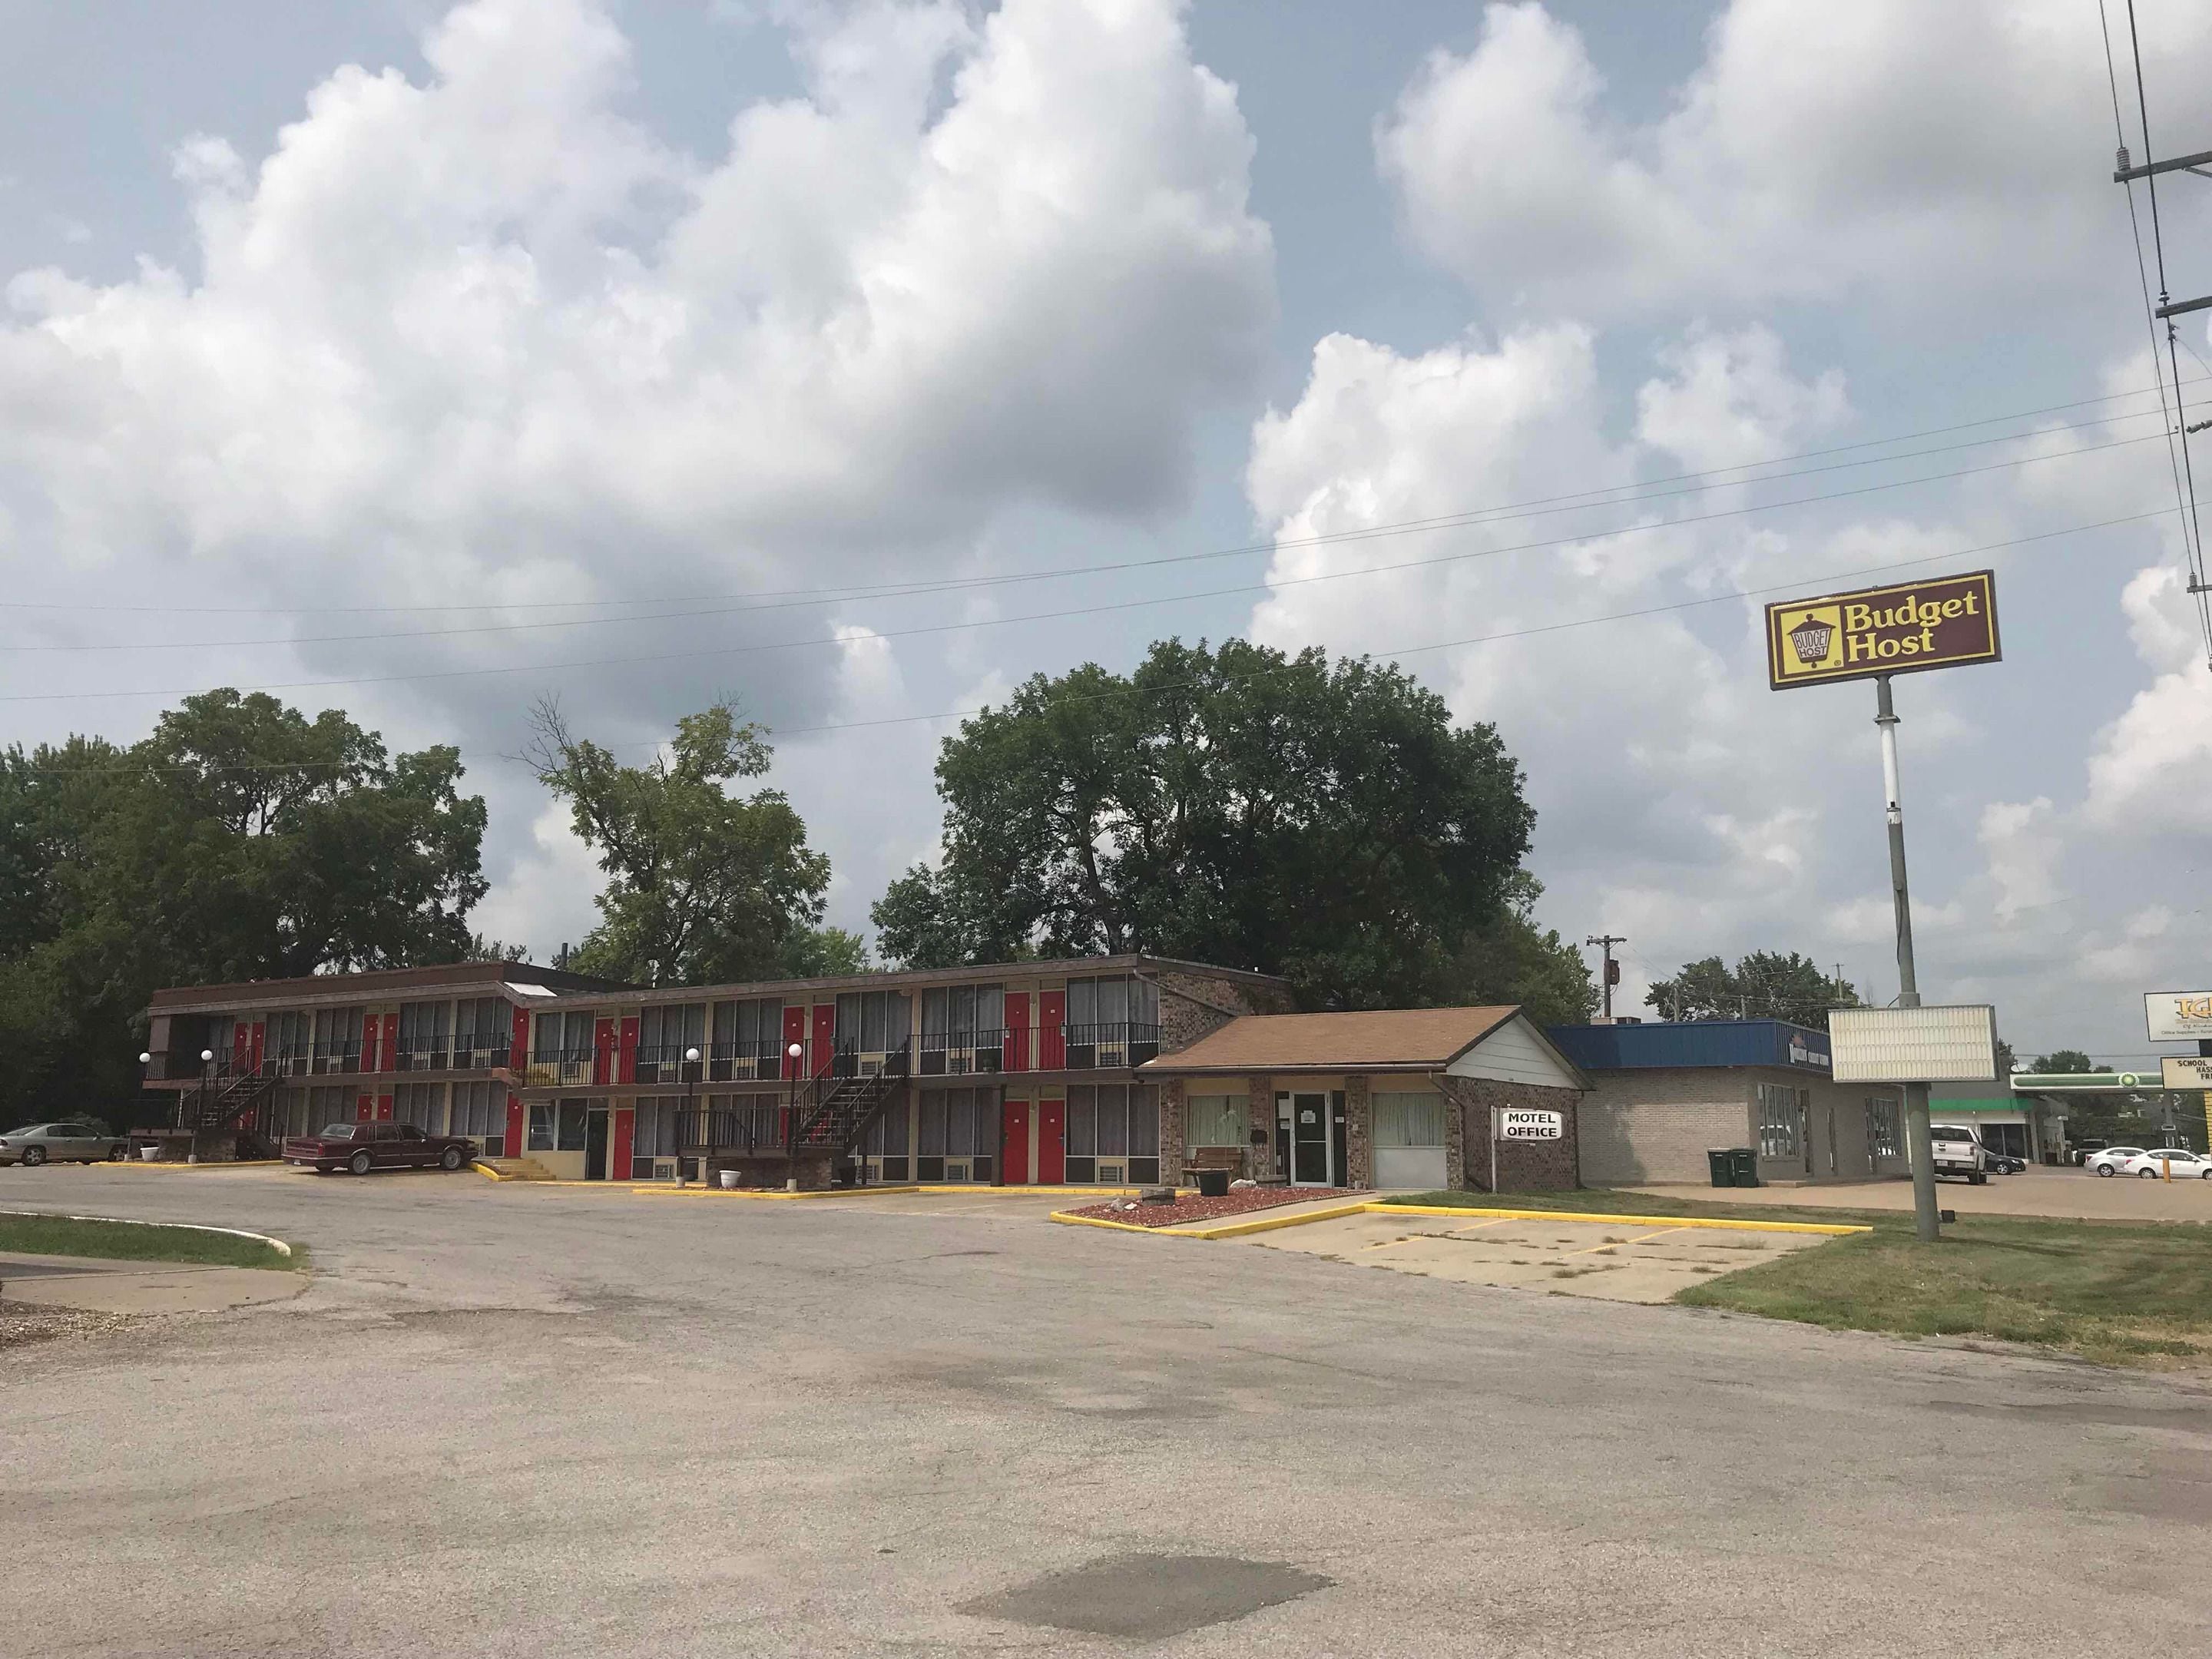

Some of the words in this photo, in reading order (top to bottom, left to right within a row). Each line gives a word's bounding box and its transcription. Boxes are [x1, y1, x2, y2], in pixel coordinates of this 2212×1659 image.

[1844, 591, 1979, 633] Budget
[1793, 629, 1830, 648] BUDGET
[1846, 628, 1936, 662] Host
[1799, 645, 1826, 657] HOST
[1508, 1113, 1556, 1123] MOTEL
[1507, 1127, 1558, 1137] OFFICE
